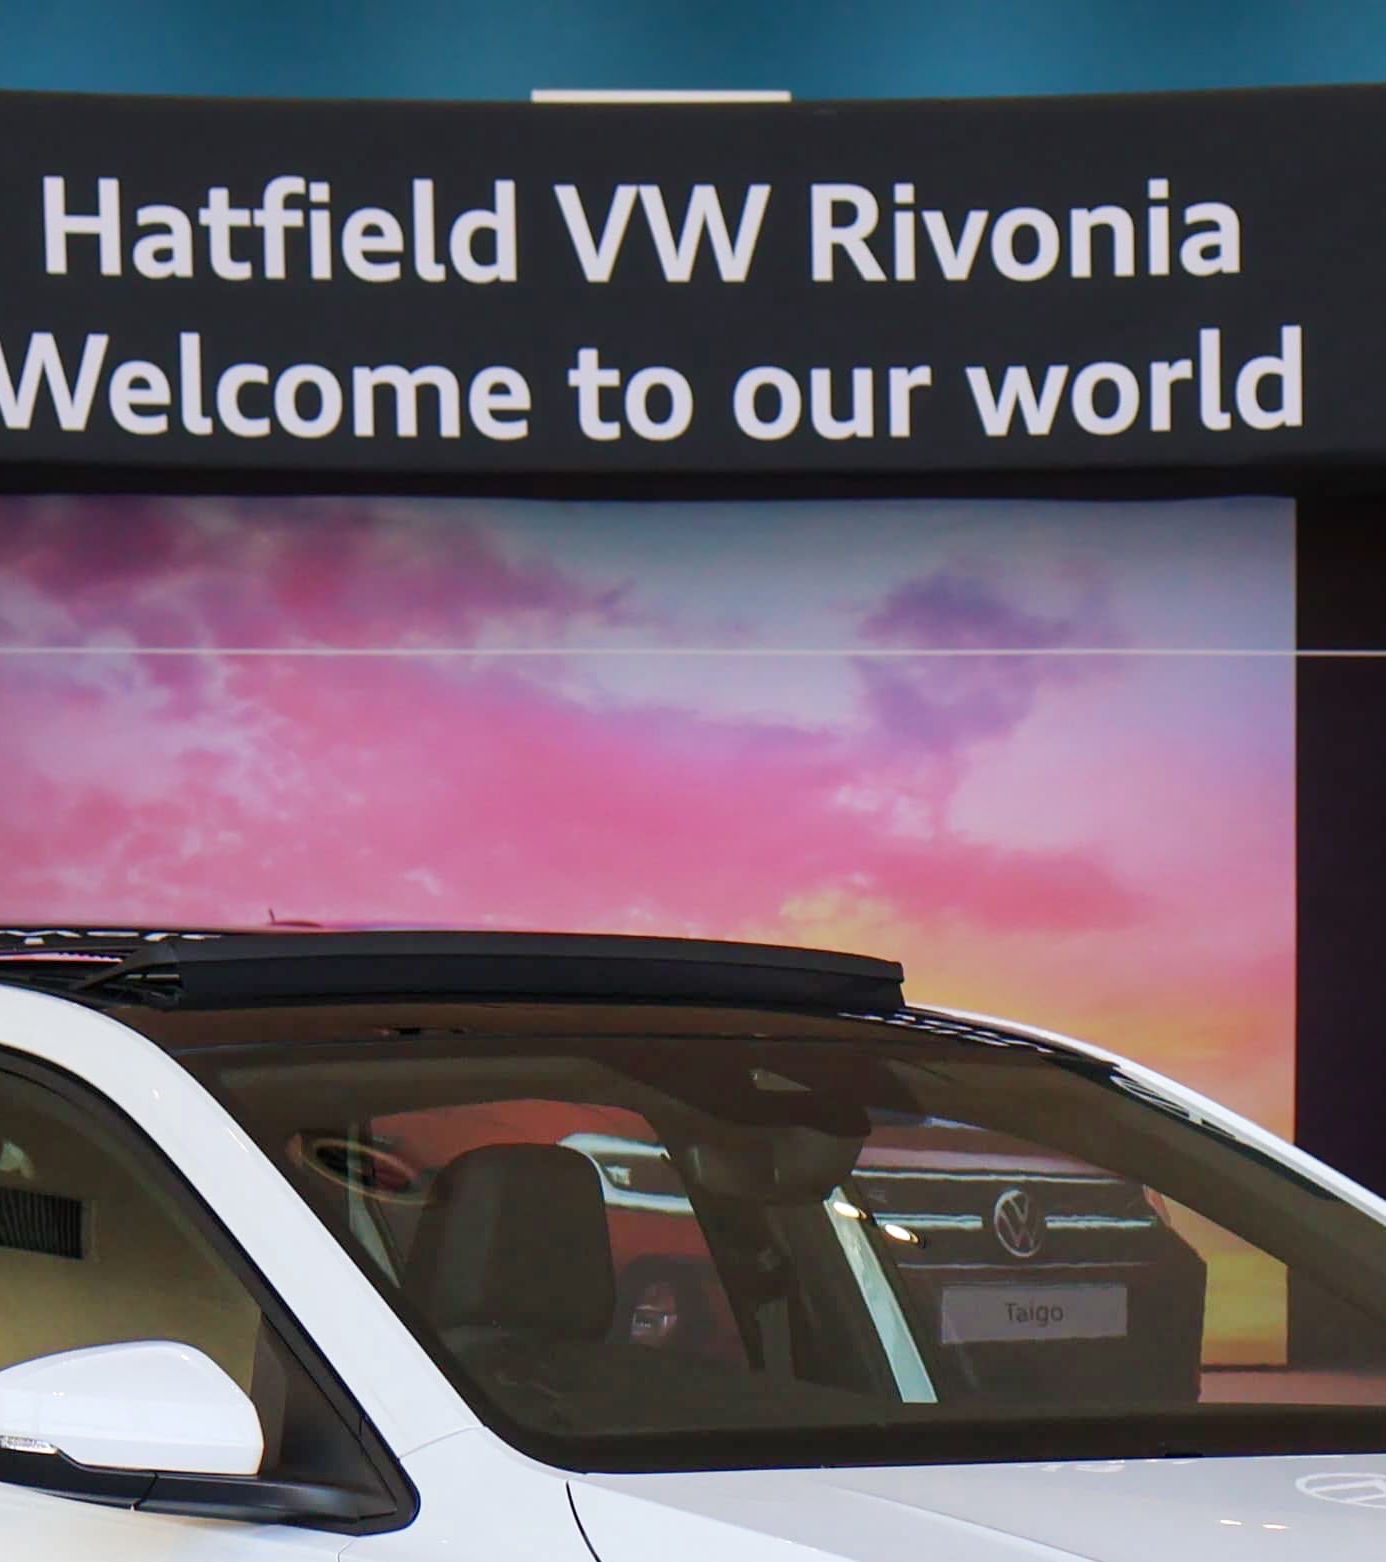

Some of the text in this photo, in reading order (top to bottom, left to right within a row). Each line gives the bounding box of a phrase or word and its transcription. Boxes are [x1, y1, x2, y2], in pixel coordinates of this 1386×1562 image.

[41, 175, 1243, 284] Hatfield VW Rivonia
[567, 346, 695, 442] to
[732, 363, 933, 442] our
[965, 324, 1304, 437] world
[1005, 1299, 1064, 1327] Taigo
